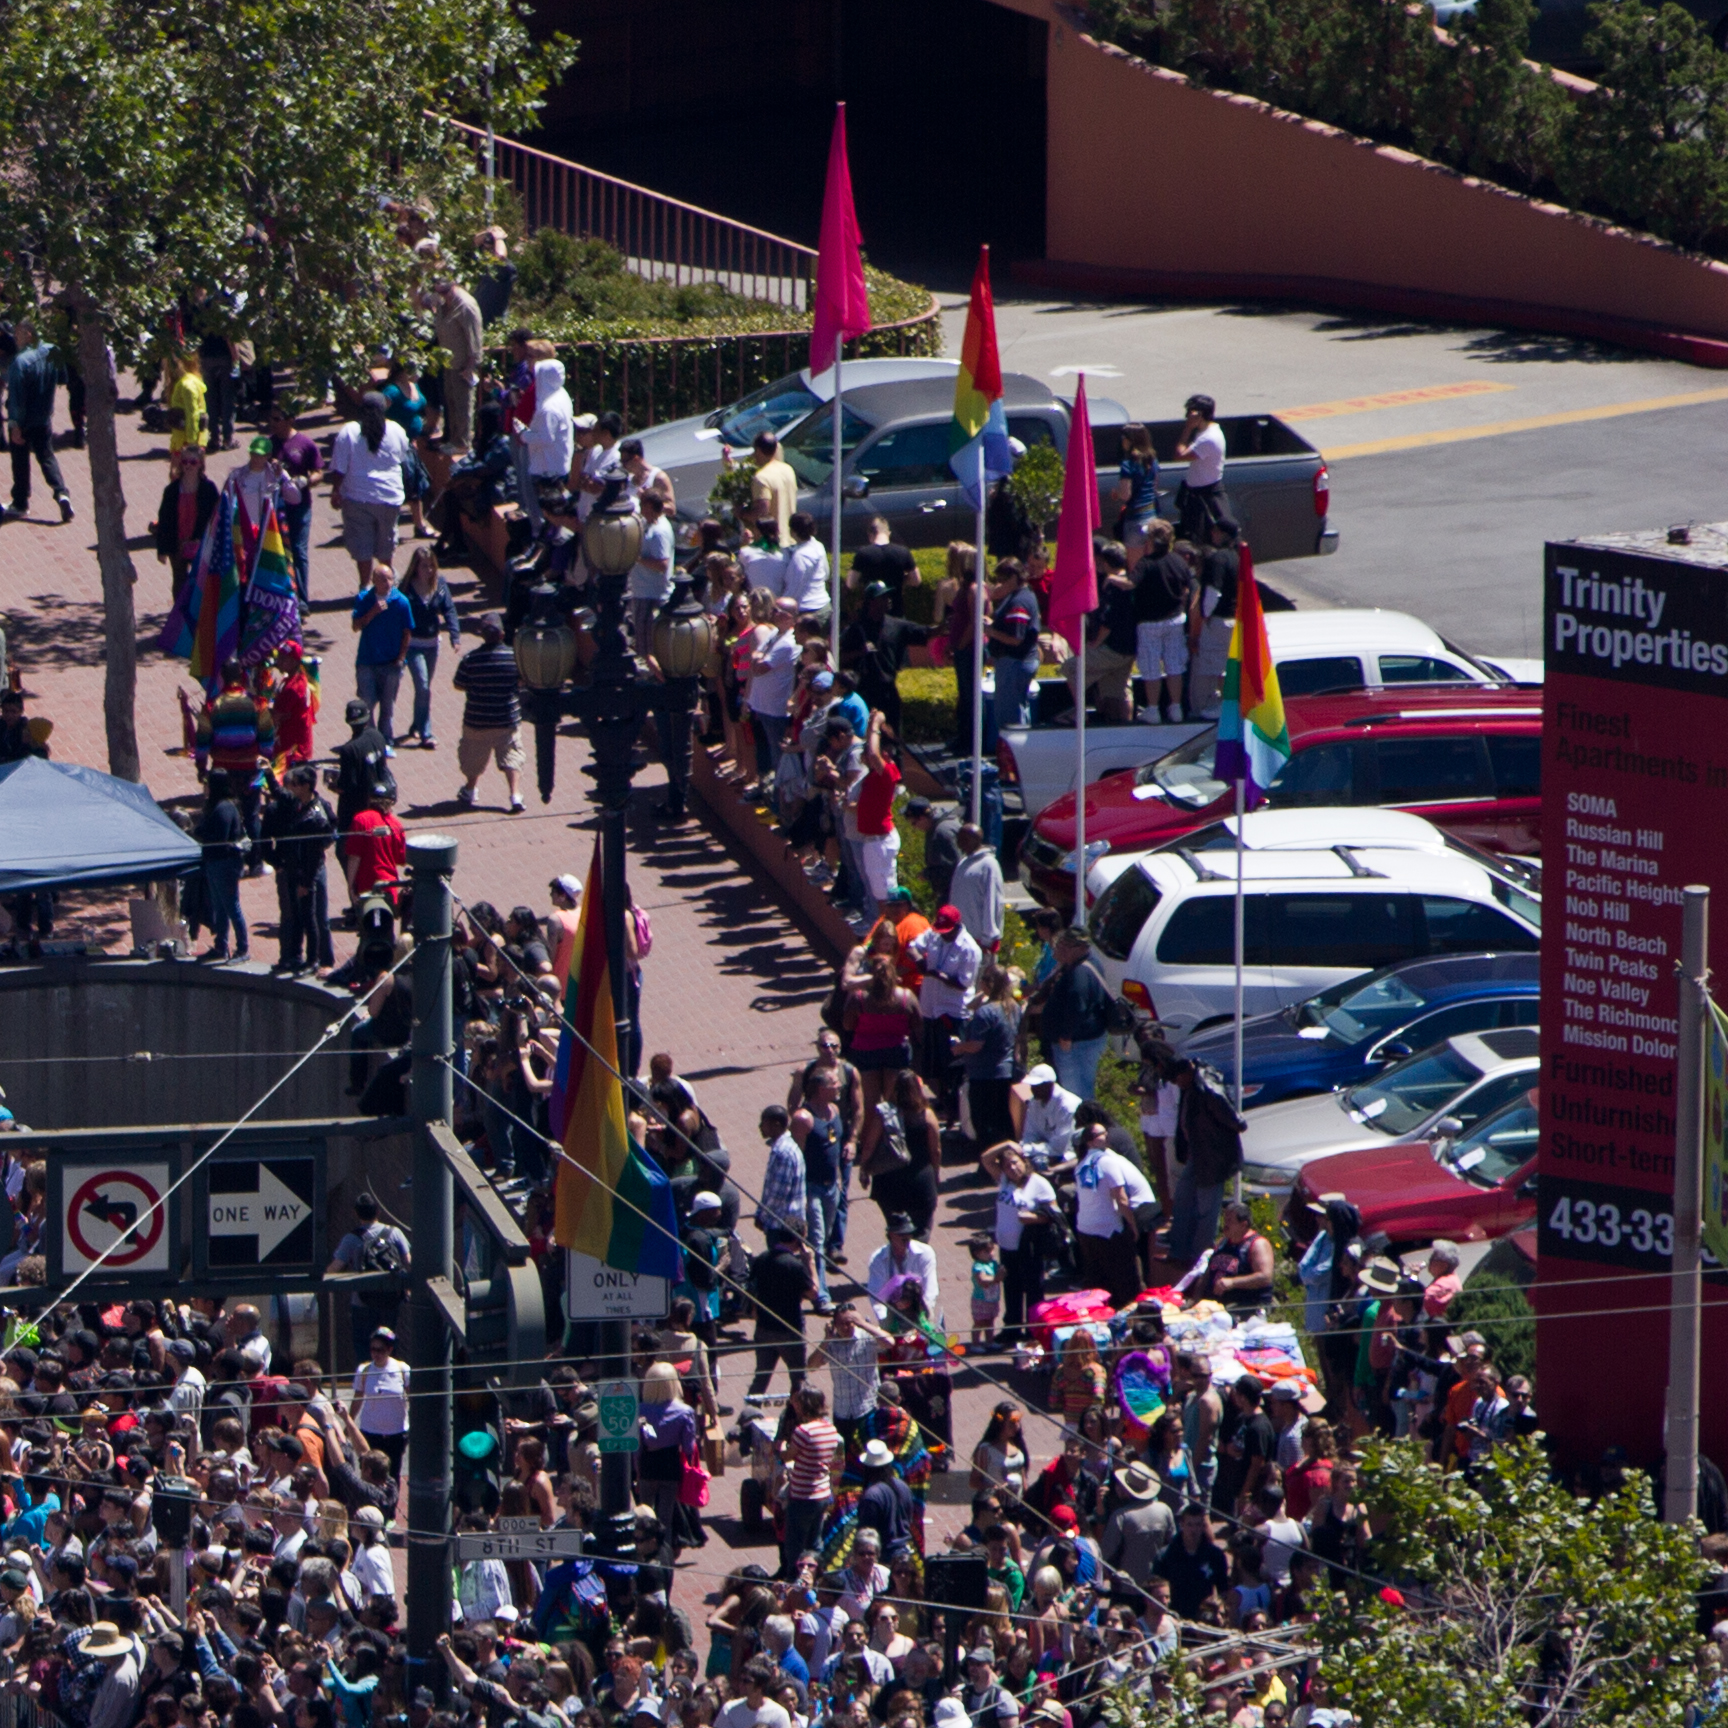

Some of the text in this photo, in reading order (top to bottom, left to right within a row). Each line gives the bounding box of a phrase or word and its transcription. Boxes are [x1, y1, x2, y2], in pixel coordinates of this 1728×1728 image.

[1556, 566, 1666, 628] Trinity
[1555, 612, 1728, 675] Properties
[1556, 702, 1630, 738] Finest
[1556, 736, 1728, 788] Apartments in
[1567, 792, 1617, 818] SOMA
[1566, 818, 1663, 850] Russian Hill
[1566, 844, 1659, 876] The Marina
[1566, 869, 1622, 896] Pacific
[1566, 895, 1630, 922] Nob Hill
[1565, 922, 1667, 956] North Beach
[1565, 947, 1658, 980] Twin Peaks
[1564, 972, 1650, 1007] Noe Valley
[1563, 998, 1594, 1021] The
[1563, 1024, 1677, 1059] Mission Dolor
[1551, 1054, 1674, 1097] Furnished
[1551, 1092, 1676, 1136] Unfurnish
[213, 1204, 301, 1223] ONE WAY
[1549, 1196, 1675, 1256] 433-33
[594, 1271, 640, 1288] ONLY
[603, 1291, 634, 1301] AT ALL
[608, 1416, 631, 1432] 50
[482, 1537, 557, 1555] 8TH ST
